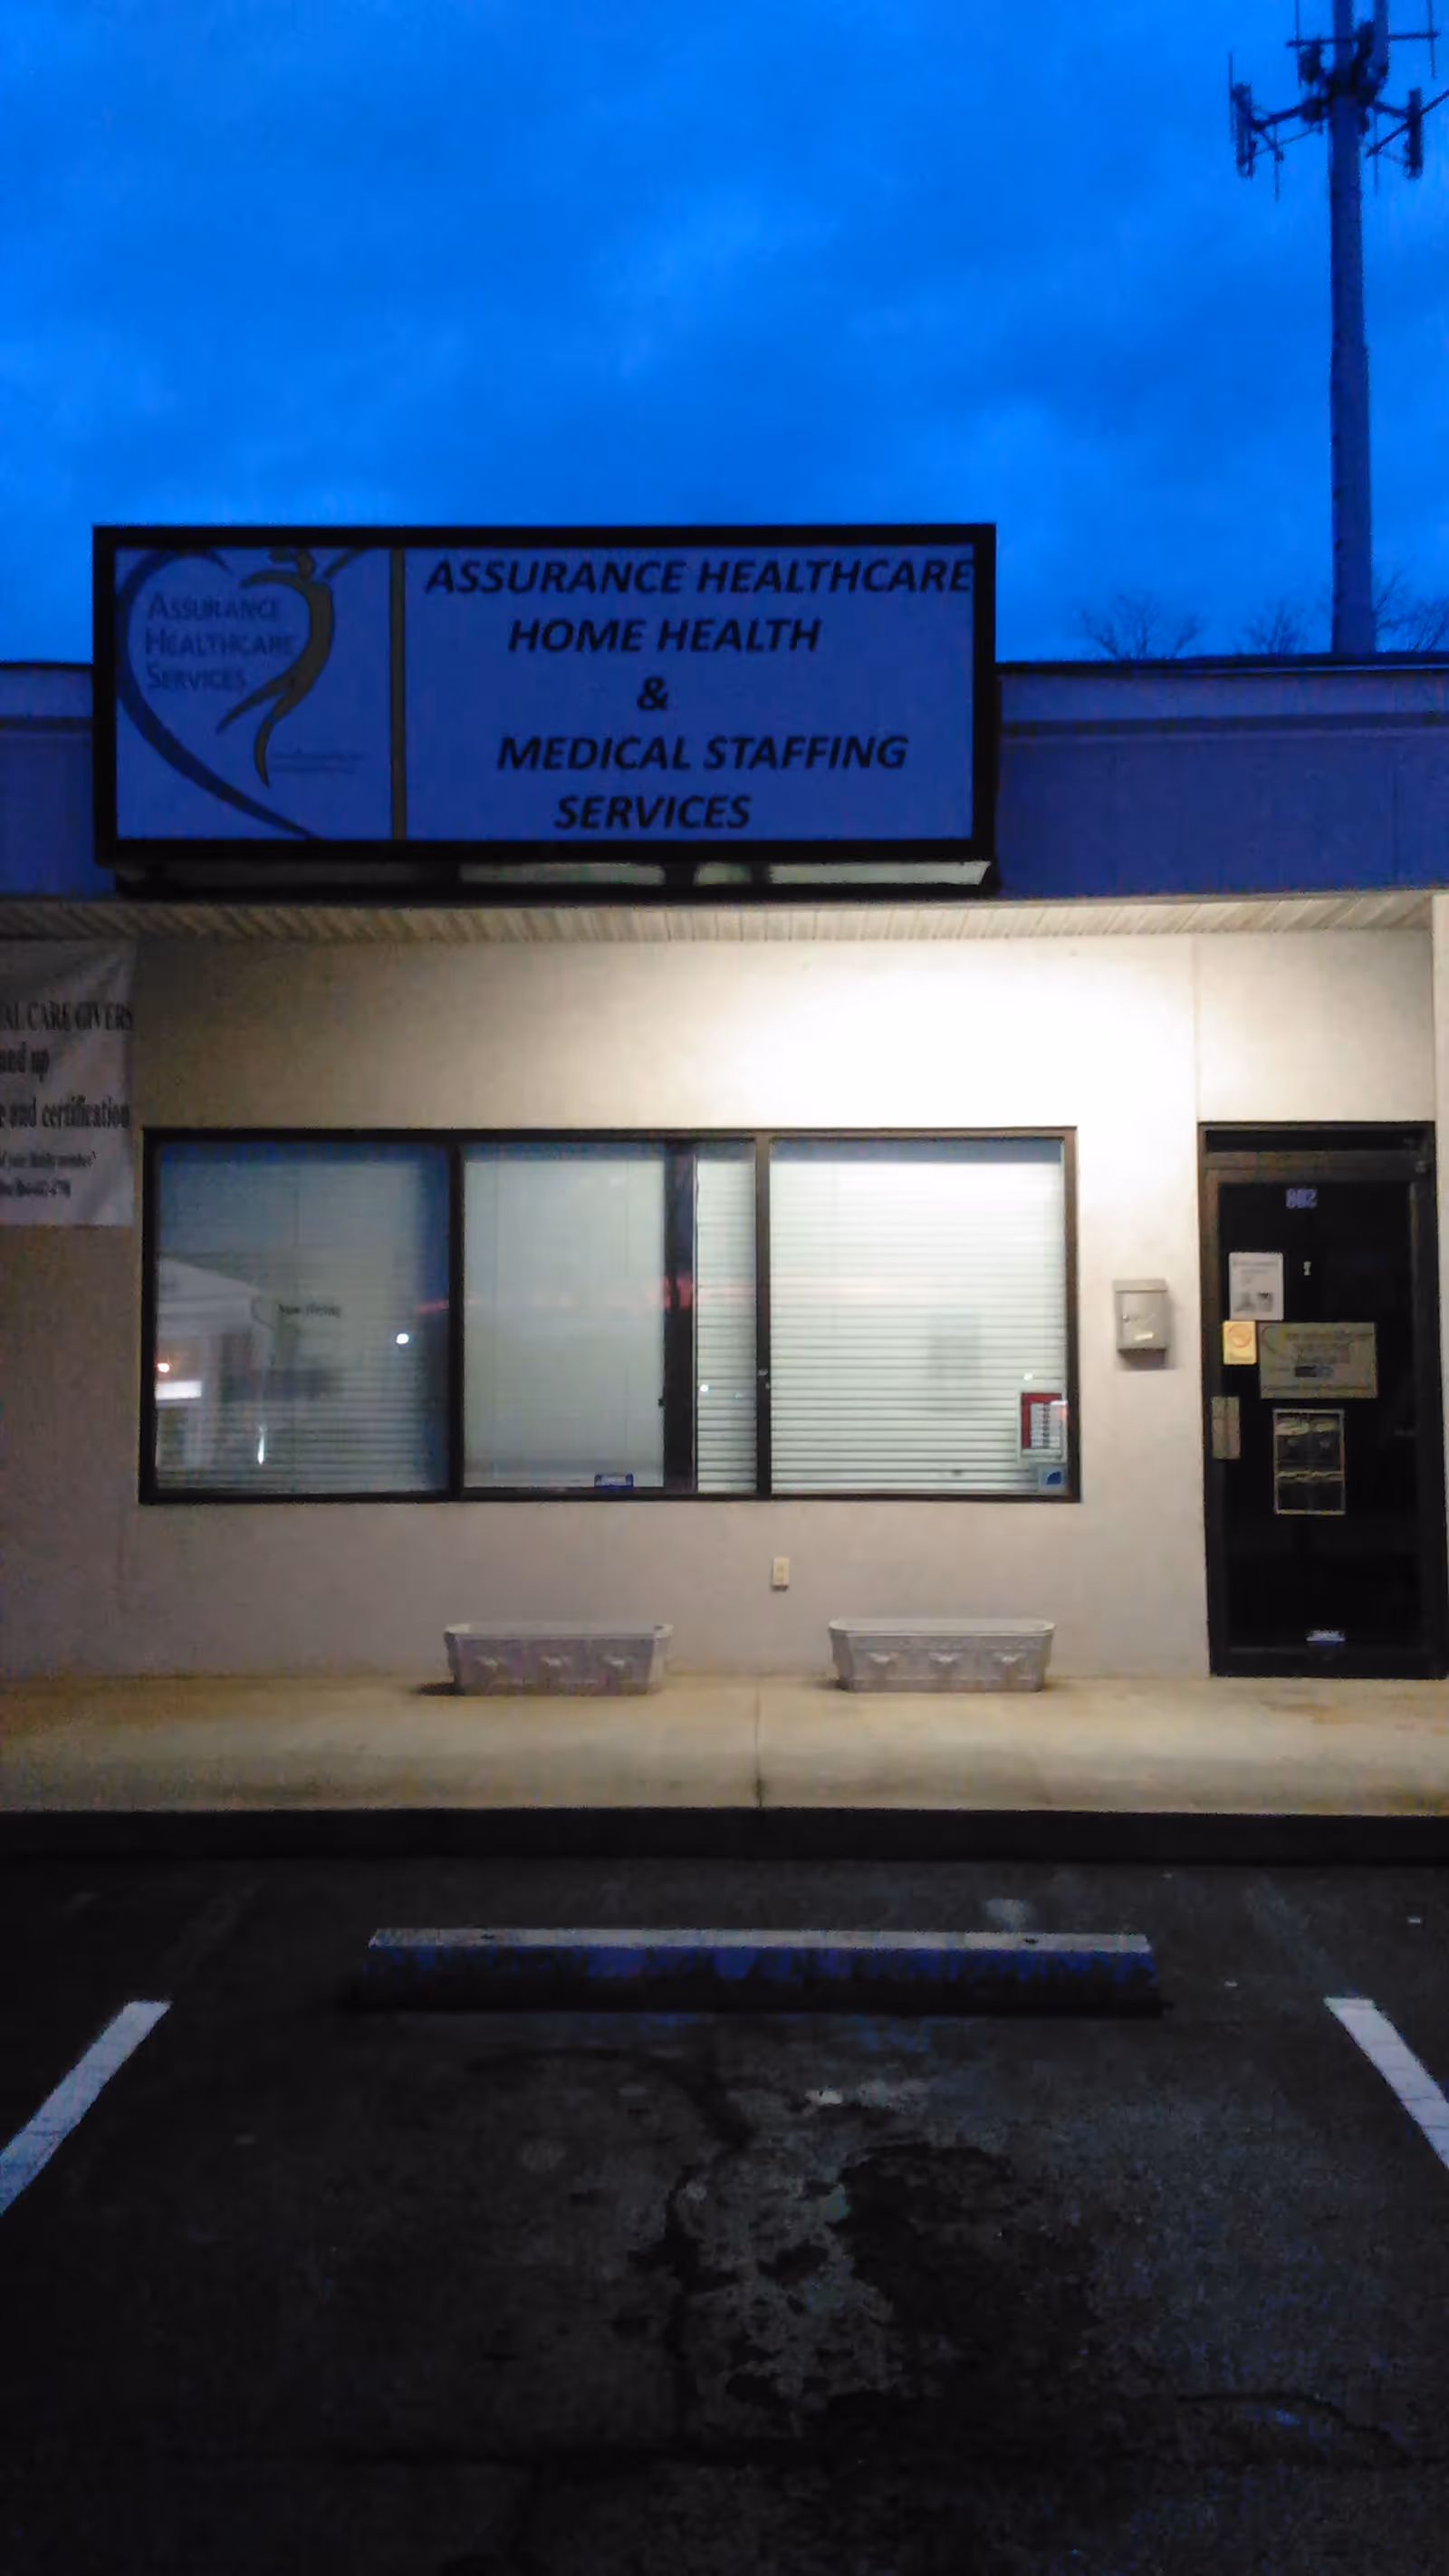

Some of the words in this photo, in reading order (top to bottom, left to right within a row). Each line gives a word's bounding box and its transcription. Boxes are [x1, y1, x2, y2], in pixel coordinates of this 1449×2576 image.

[427, 560, 686, 593] ASSURANCE
[697, 557, 973, 592] HEALTHCARE
[508, 620, 645, 652] HOME
[657, 619, 820, 651] HEALTH
[638, 677, 667, 710] &
[498, 735, 690, 770] MEDICAL
[704, 736, 908, 770] STAFFING
[554, 795, 751, 830] SERVICES
[26, 1001, 71, 1031] CARE
